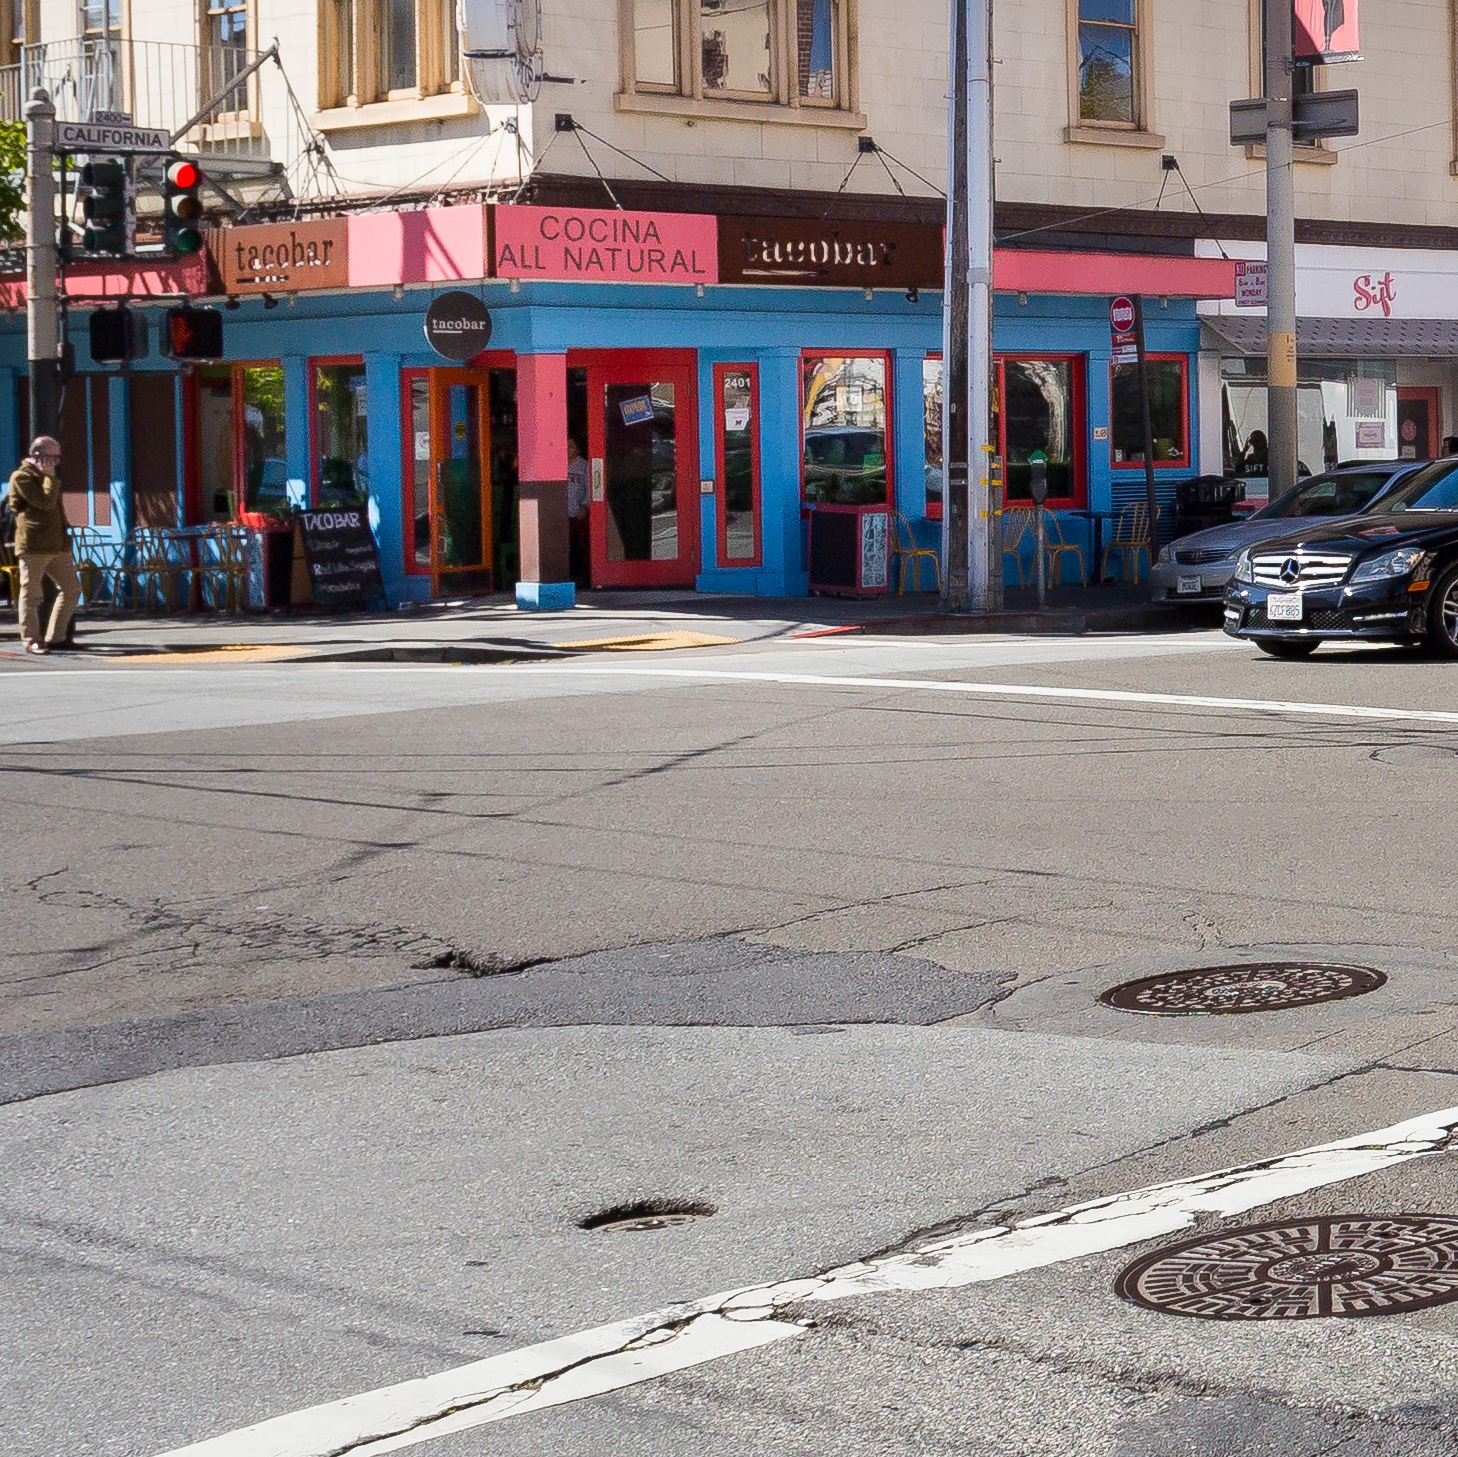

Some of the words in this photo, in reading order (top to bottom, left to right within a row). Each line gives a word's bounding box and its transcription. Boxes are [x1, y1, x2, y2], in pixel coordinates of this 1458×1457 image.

[63, 126, 163, 147] CALIFORNIA
[539, 215, 662, 244] COCINA
[235, 231, 334, 271] tacobar
[498, 244, 546, 271] ALL
[562, 246, 707, 275] NATURAL
[1353, 272, 1397, 317] Sift
[432, 317, 486, 331] tacobar
[725, 378, 750, 388] 2401
